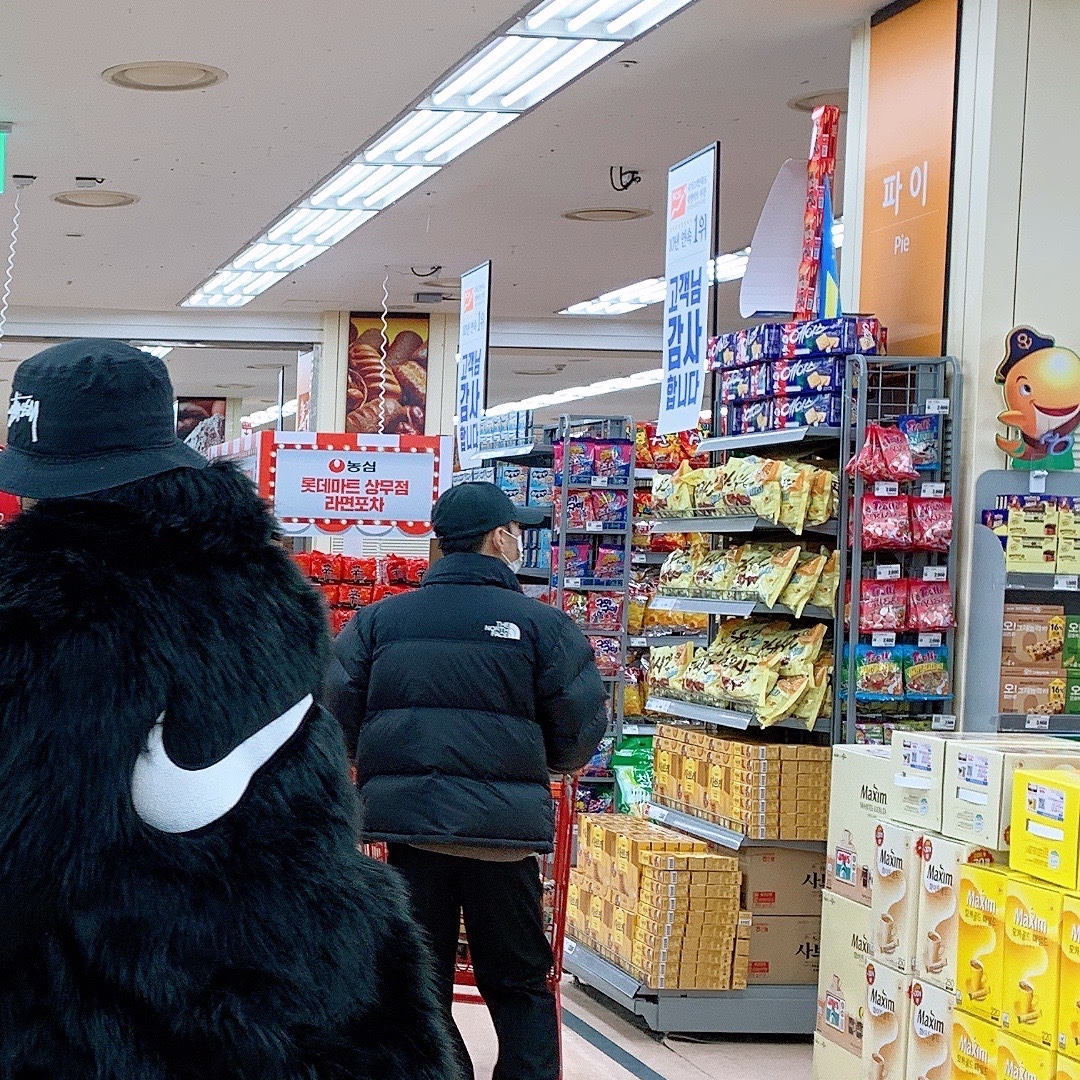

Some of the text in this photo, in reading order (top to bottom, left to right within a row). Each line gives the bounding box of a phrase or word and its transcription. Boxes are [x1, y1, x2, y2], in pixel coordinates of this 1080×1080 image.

[893, 234, 910, 255] Pie
[668, 266, 702, 313] 고객님
[668, 309, 703, 371] 감사
[461, 348, 482, 380] 고객님
[460, 378, 480, 423] 감사
[666, 369, 700, 411] 합니다
[460, 423, 478, 452] 합니다
[347, 460, 376, 473] 농심
[301, 477, 409, 496] 롯데마트 상무점
[324, 496, 385, 513] 라면포차
[860, 784, 887, 805] Maxim
[879, 849, 903, 870] Maxim
[926, 864, 953, 886] Maxim
[966, 890, 997, 915] Maxim
[1014, 907, 1048, 934] Maxim
[870, 987, 895, 1012] Maxim
[916, 1009, 944, 1034] Maxim
[959, 1034, 989, 1064] Maxim
